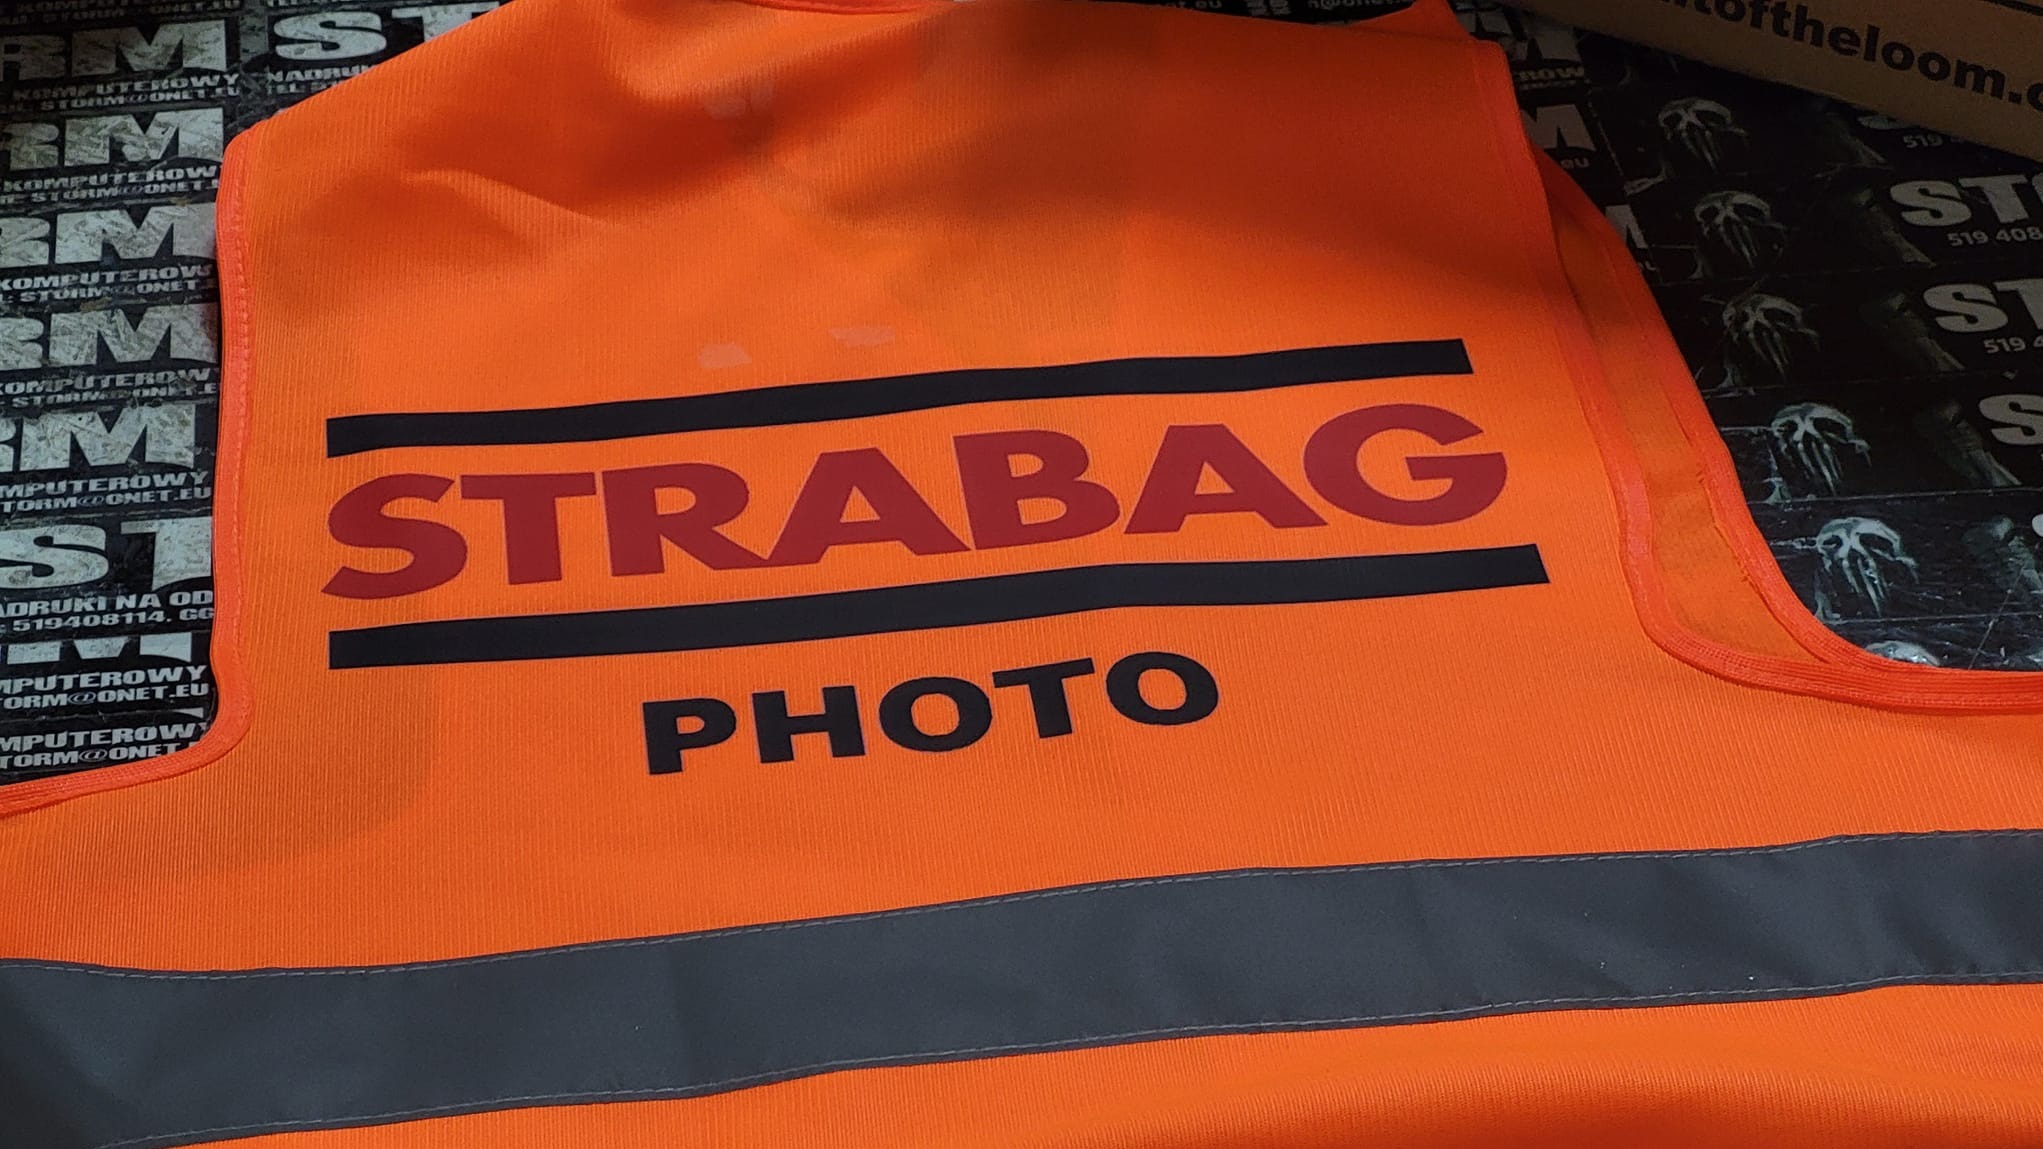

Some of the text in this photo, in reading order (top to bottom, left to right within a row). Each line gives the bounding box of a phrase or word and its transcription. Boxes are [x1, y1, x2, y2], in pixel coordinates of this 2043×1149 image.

[1675, 0, 2043, 112] oftheloom.c
[1890, 173, 2043, 228] ST
[1947, 231, 1990, 247] 519
[1983, 336, 2027, 355] 519
[0, 367, 211, 396] OMPUTEROW
[321, 403, 1508, 600] STRABAG
[0, 595, 107, 619] DRUKI
[116, 592, 161, 611] NA
[0, 683, 209, 710] ORM@ONET.EU
[643, 651, 1218, 775] PHOTO
